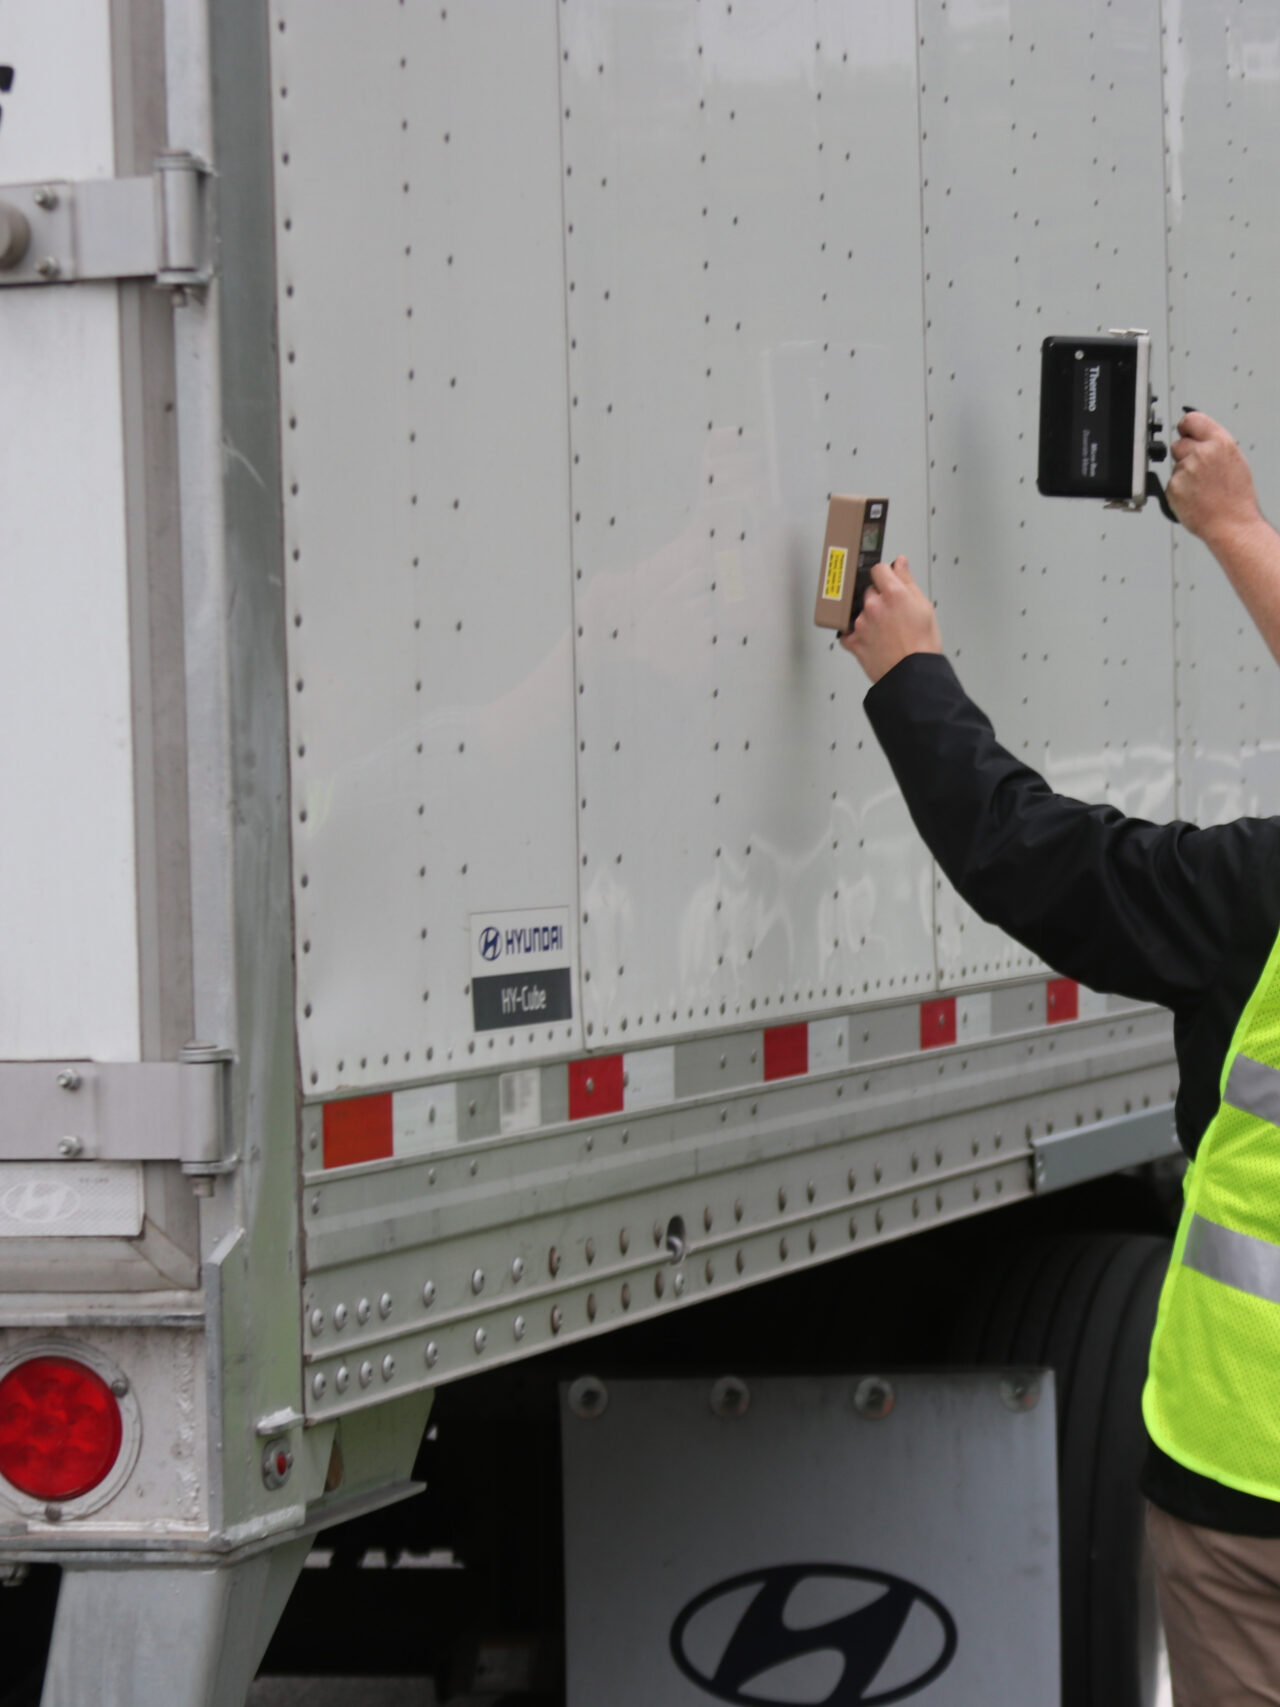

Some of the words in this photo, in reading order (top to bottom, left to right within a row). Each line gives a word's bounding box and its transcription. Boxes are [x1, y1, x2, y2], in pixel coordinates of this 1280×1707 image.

[1088, 365, 1100, 412] Thermo
[505, 925, 563, 955] HYUNDAI
[501, 984, 547, 1014] HY-Cube
